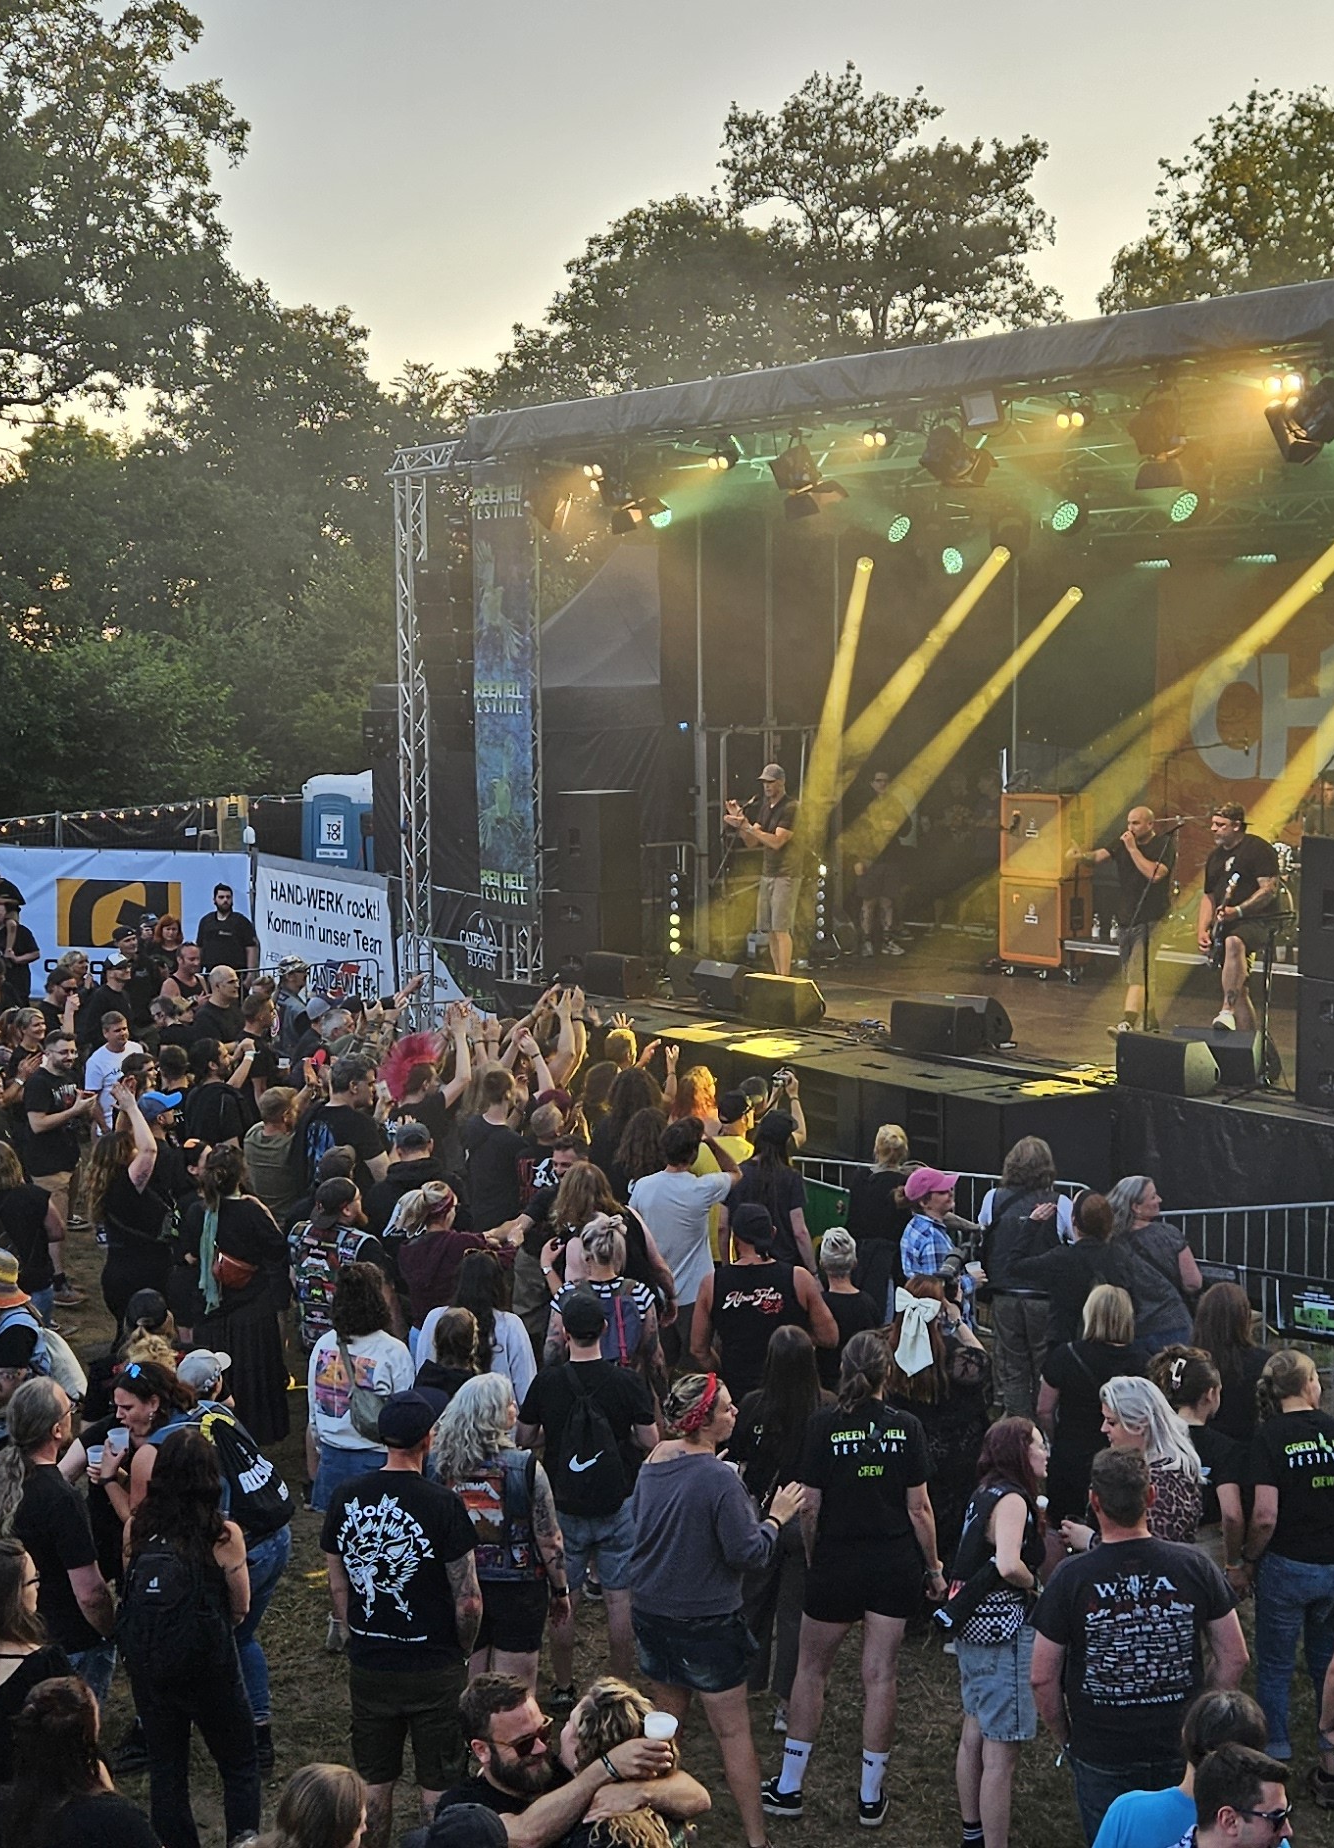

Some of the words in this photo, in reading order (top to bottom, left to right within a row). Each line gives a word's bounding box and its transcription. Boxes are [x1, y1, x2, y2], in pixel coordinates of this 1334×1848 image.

[269, 879, 345, 915] HAND-WERK
[347, 898, 381, 922] rockt!
[267, 910, 303, 938] Komm
[304, 919, 315, 941] in
[318, 927, 351, 949] unser
[831, 1430, 866, 1443] GREEN
[883, 1429, 907, 1441] HELL
[1284, 1440, 1318, 1455] GREEN
[857, 1465, 884, 1477] CREW
[391, 1506, 436, 1559] STRAY
